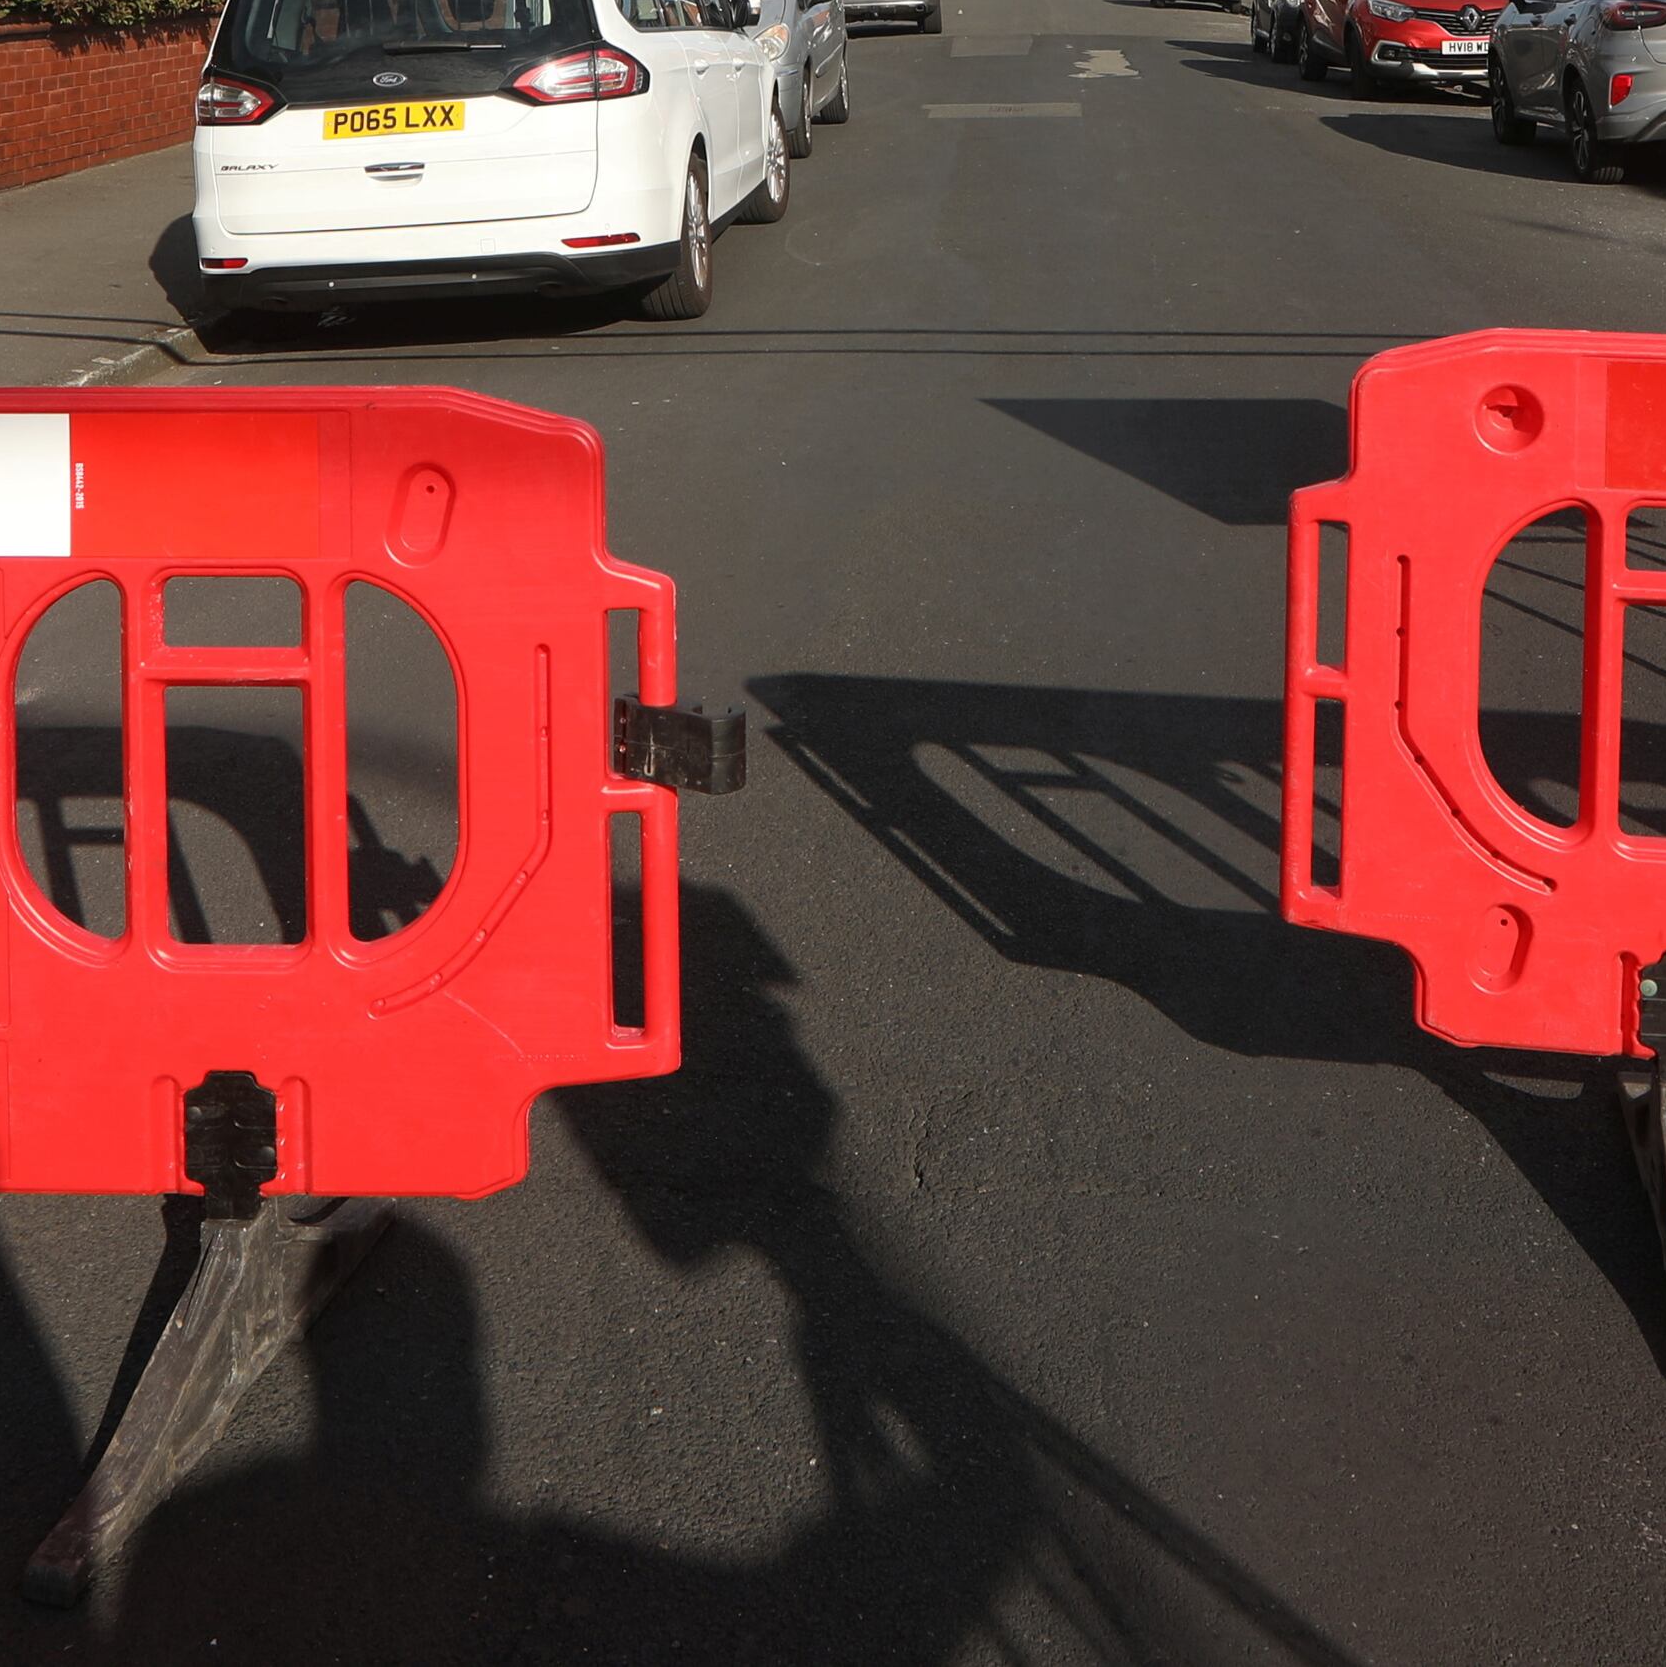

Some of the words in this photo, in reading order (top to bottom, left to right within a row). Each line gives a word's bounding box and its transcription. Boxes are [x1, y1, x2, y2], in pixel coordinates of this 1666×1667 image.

[1449, 42, 1473, 52] HV18
[333, 107, 397, 134] PO65
[405, 105, 454, 132] LXX
